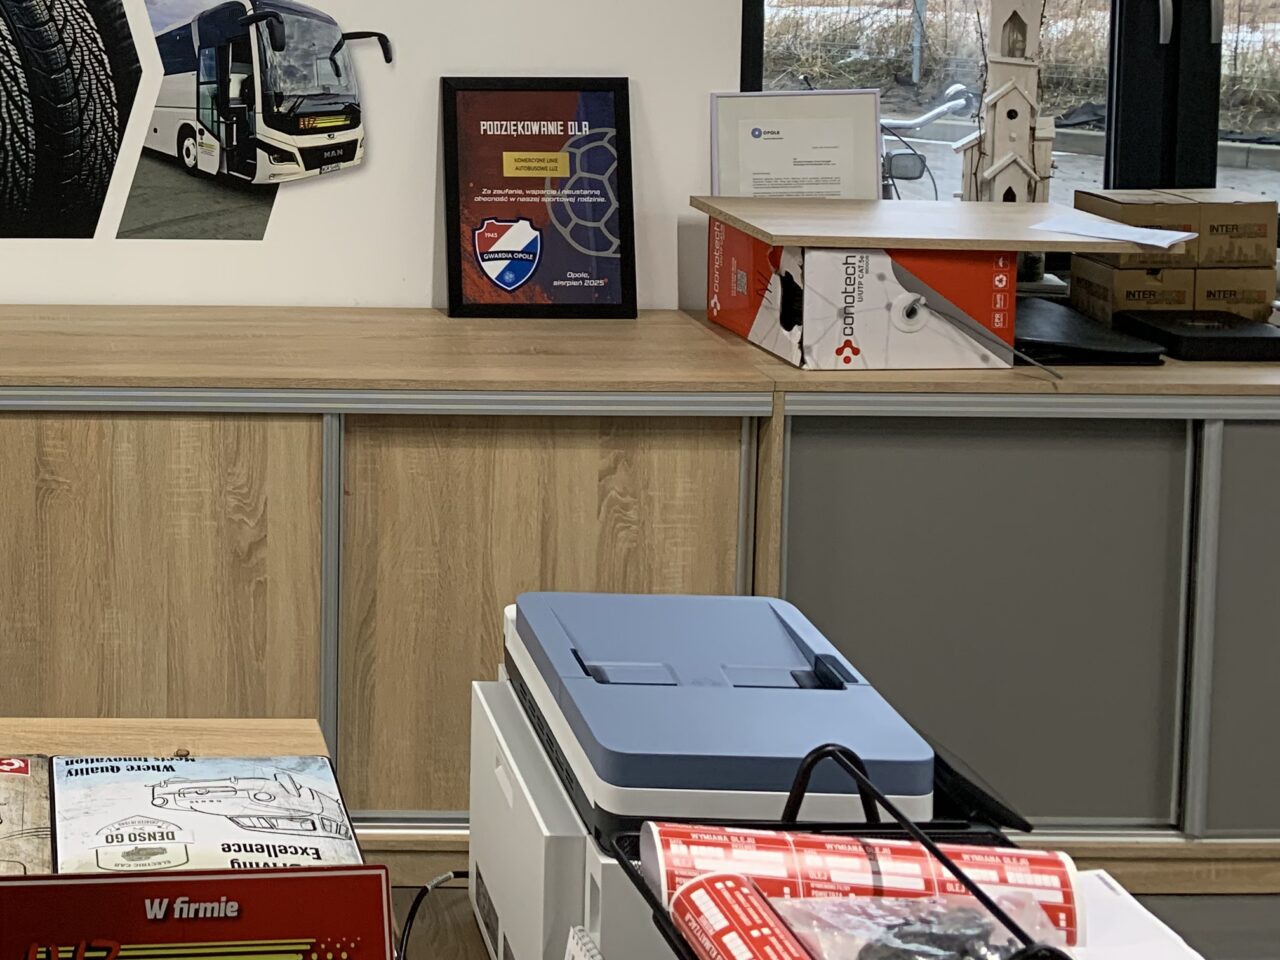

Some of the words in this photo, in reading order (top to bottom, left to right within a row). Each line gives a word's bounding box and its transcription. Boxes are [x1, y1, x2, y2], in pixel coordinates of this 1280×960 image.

[480, 121, 564, 137] PODZIĘKOWANIE
[567, 121, 590, 135] DLA
[324, 149, 344, 159] MAN
[1209, 223, 1239, 233] INTER
[483, 252, 513, 260] GWARDIA
[513, 252, 533, 260] OPOLE
[841, 255, 856, 337] conotech
[1125, 289, 1156, 300] INTER
[1206, 289, 1238, 299] INTER
[66, 765, 121, 778] Quality
[126, 764, 176, 773] Where
[105, 833, 125, 844] GO
[129, 831, 176, 842] DENSO
[690, 833, 729, 843] WYMIANA
[221, 843, 322, 860] Excellence
[825, 843, 864, 853] WYMIANA
[961, 853, 1002, 864] WYMIANA
[145, 898, 168, 919] W
[173, 896, 239, 919] firmie
